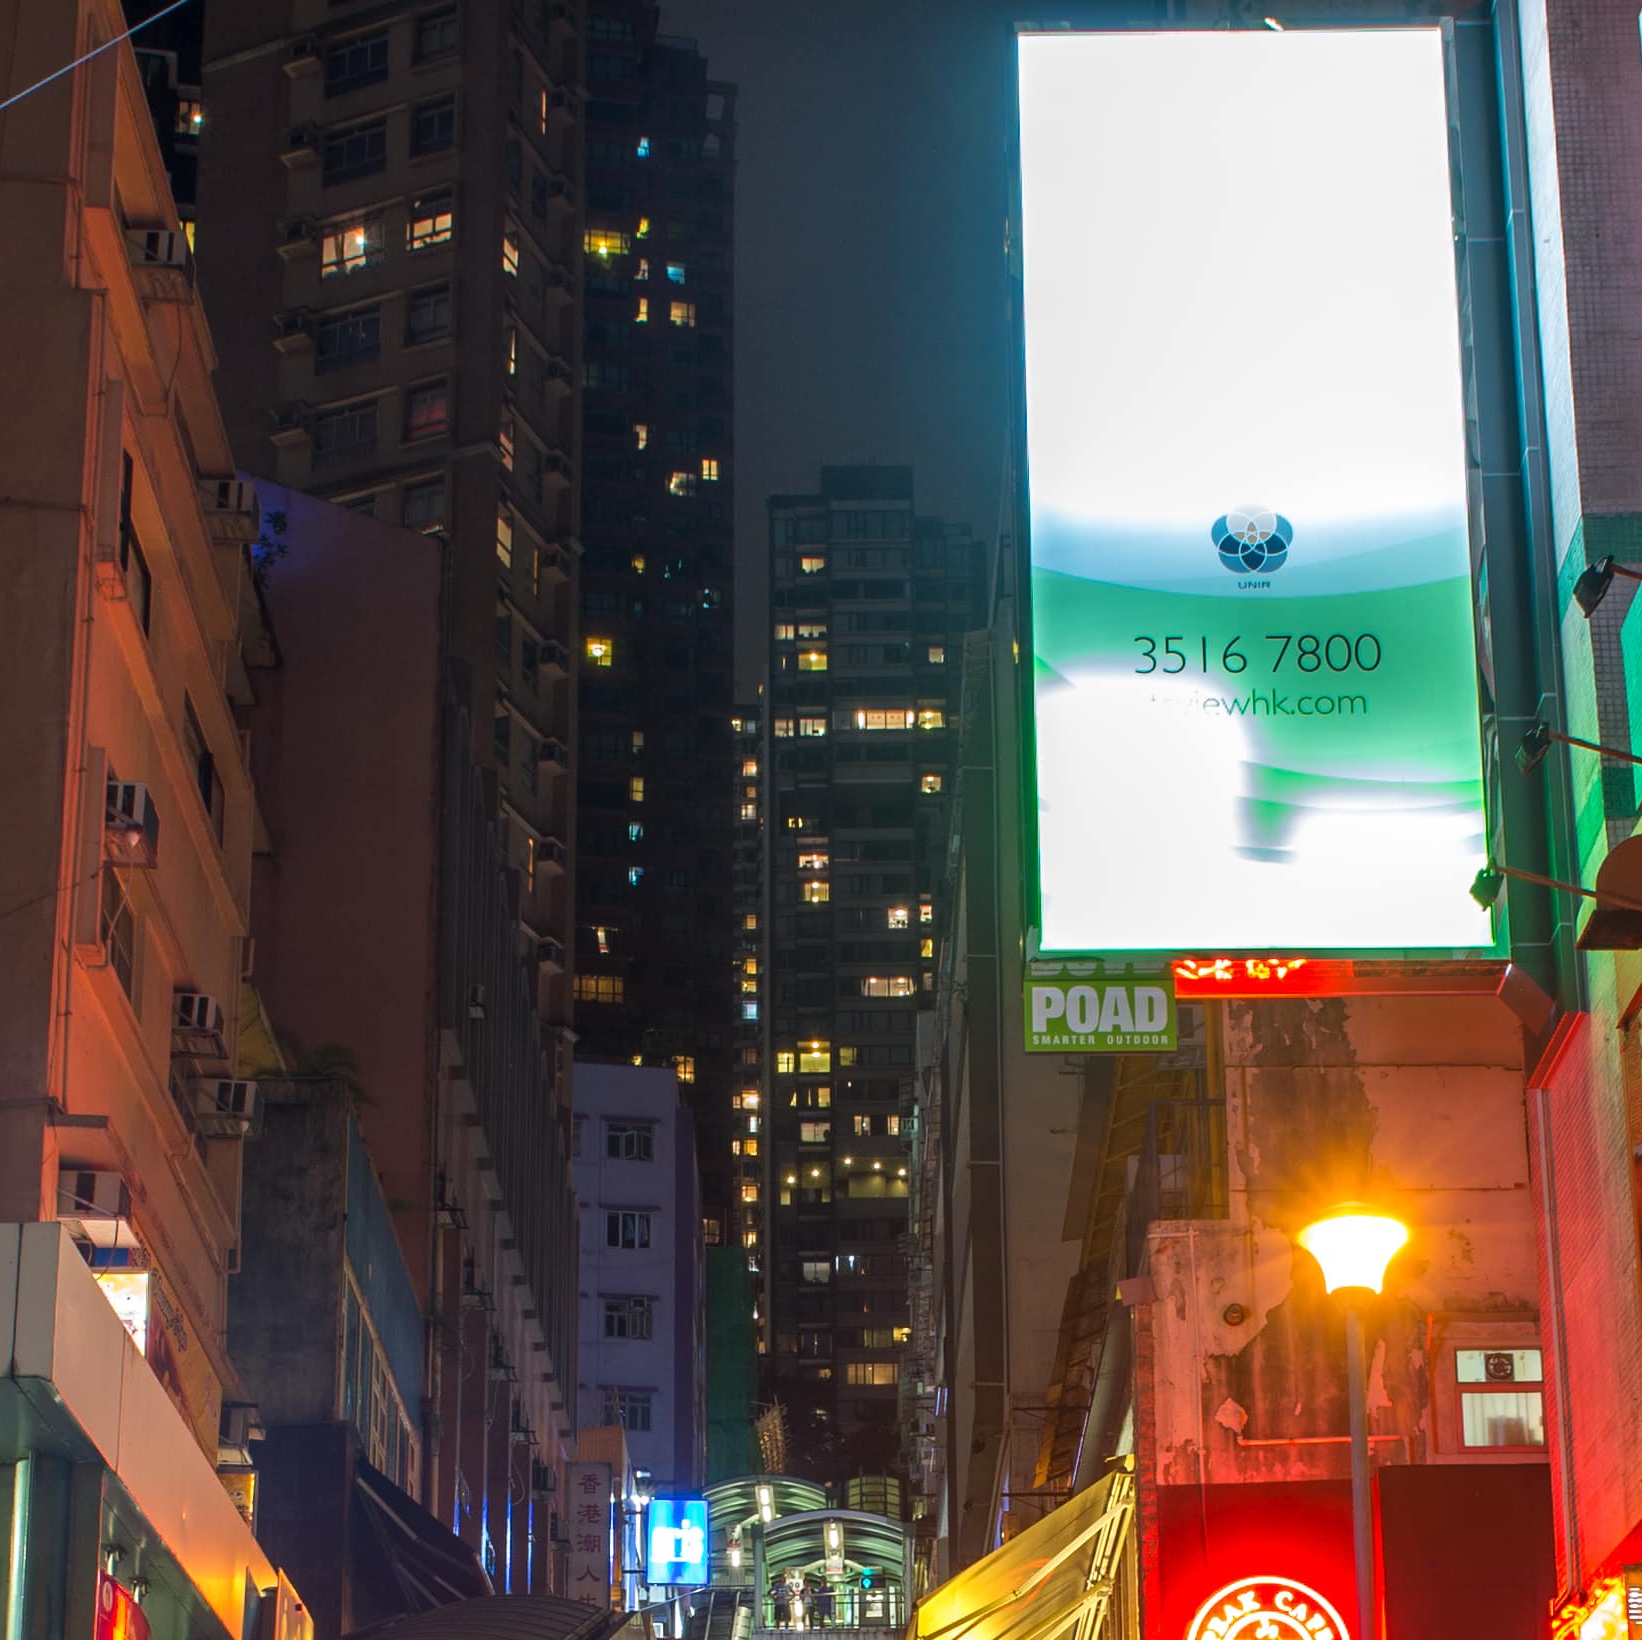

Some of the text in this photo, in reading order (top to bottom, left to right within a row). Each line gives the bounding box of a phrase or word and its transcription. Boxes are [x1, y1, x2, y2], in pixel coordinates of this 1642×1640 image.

[1134, 633, 1382, 674] 3516 7800
[1031, 985, 1168, 1033] POAD
[1032, 1034, 1169, 1046] SMARTER OUTDOOR
